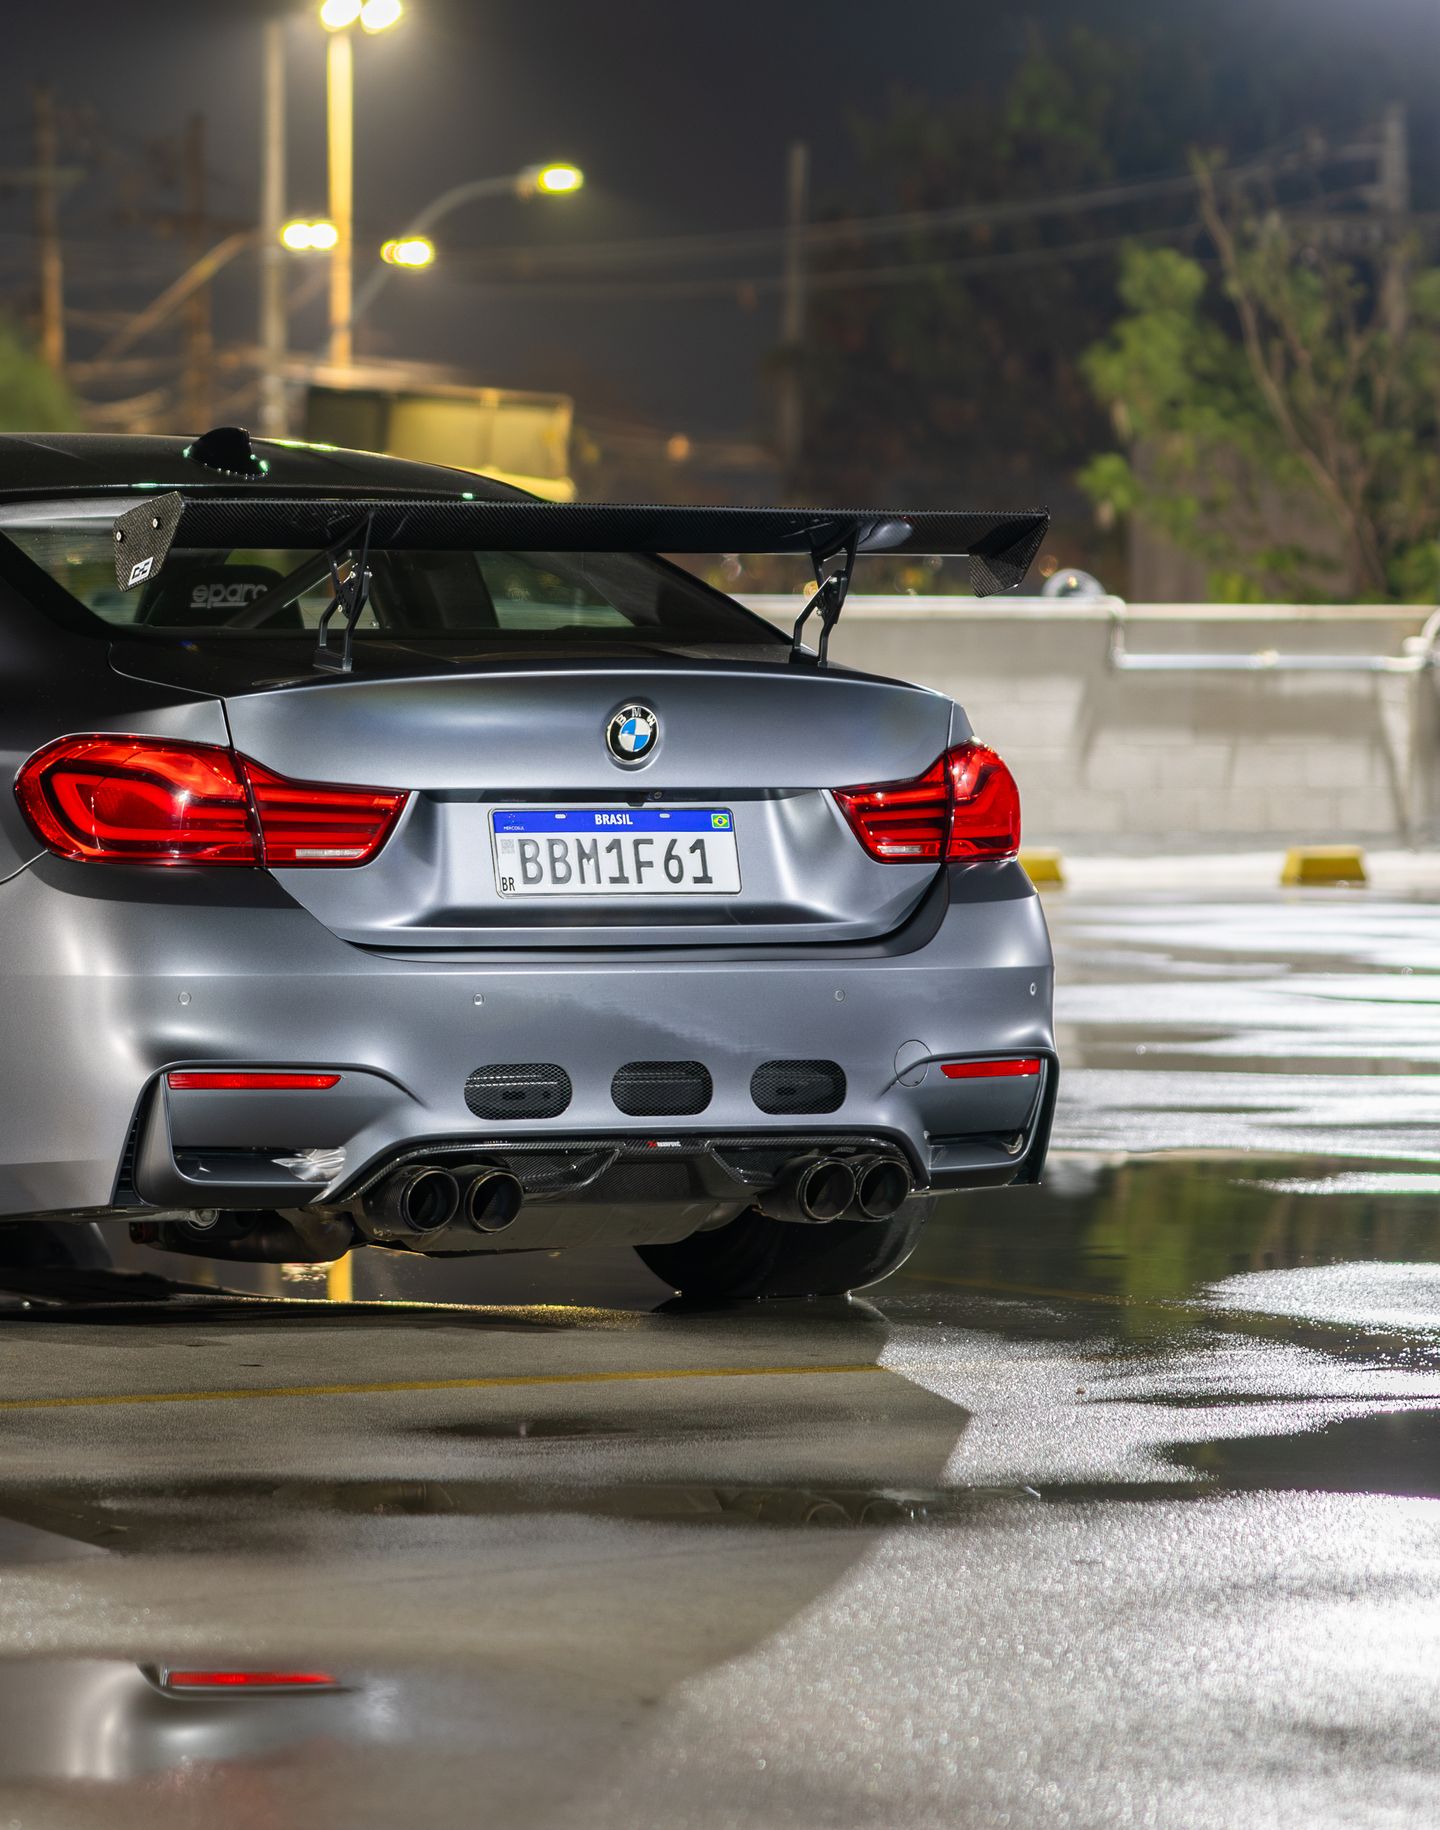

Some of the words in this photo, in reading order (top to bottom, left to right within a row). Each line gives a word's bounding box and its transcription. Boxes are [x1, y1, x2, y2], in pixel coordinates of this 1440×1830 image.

[594, 813, 634, 826] BRASIL
[517, 838, 713, 885] BBM1F61
[501, 876, 516, 892] BR
